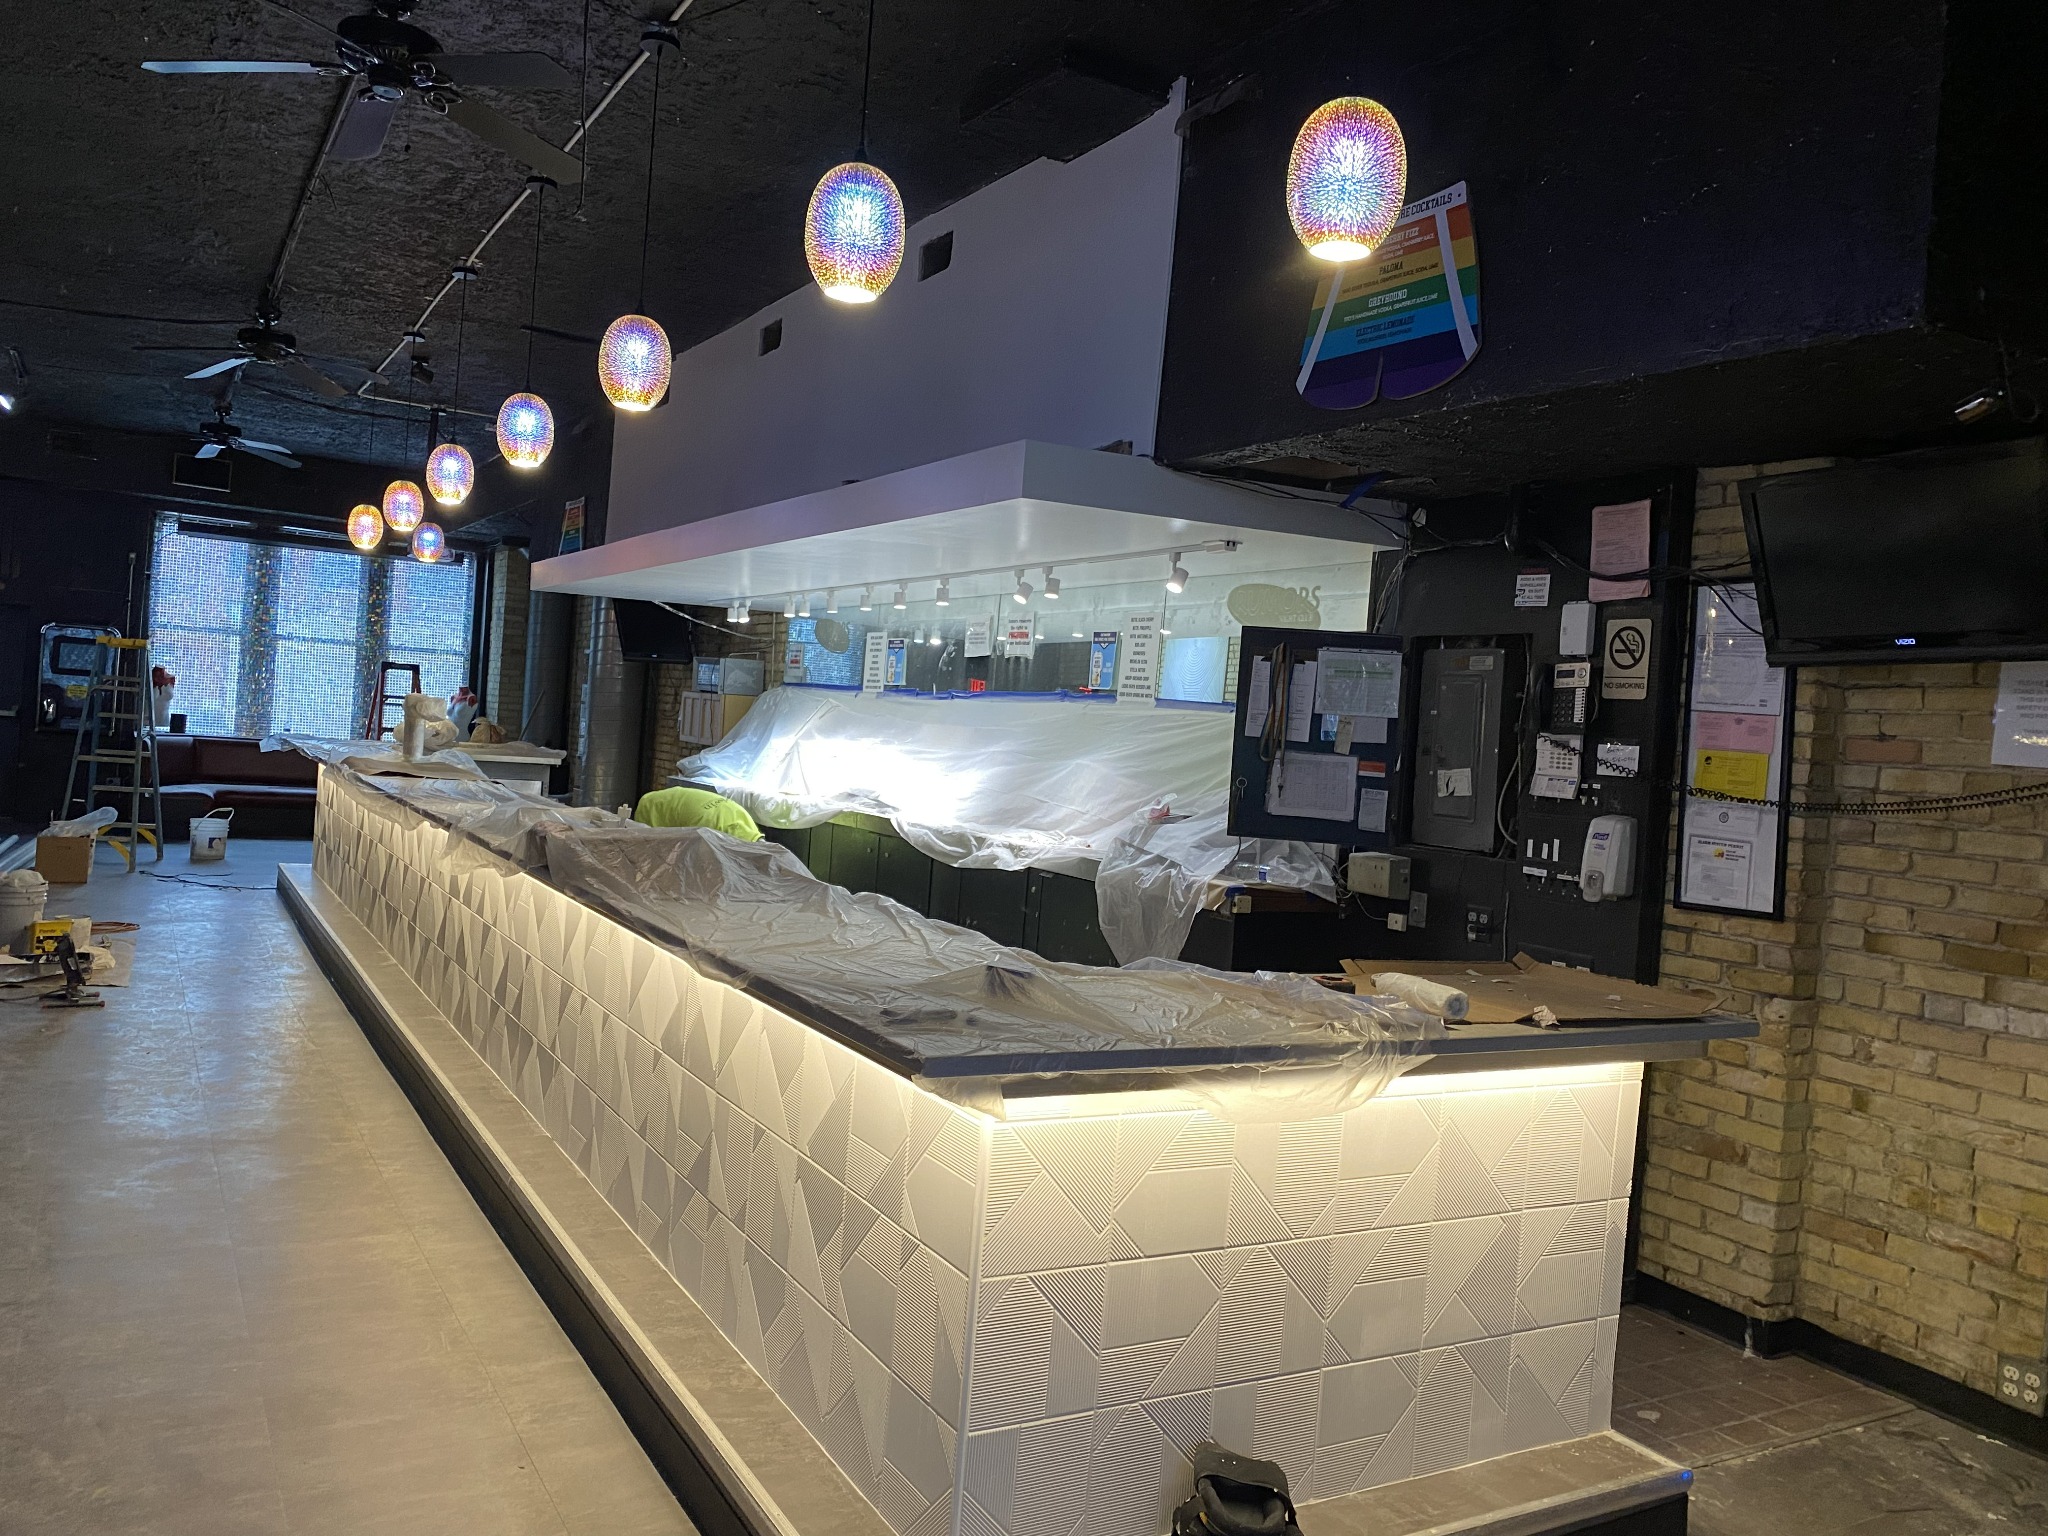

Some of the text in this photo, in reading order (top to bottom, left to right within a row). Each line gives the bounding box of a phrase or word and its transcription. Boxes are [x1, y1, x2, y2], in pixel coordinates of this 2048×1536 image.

[1411, 192, 1453, 215] COCKTAILS
[1378, 261, 1404, 276] PALOMA
[1368, 288, 1408, 308] GREYHOUND
[1604, 682, 1645, 690] NO SMOKING
